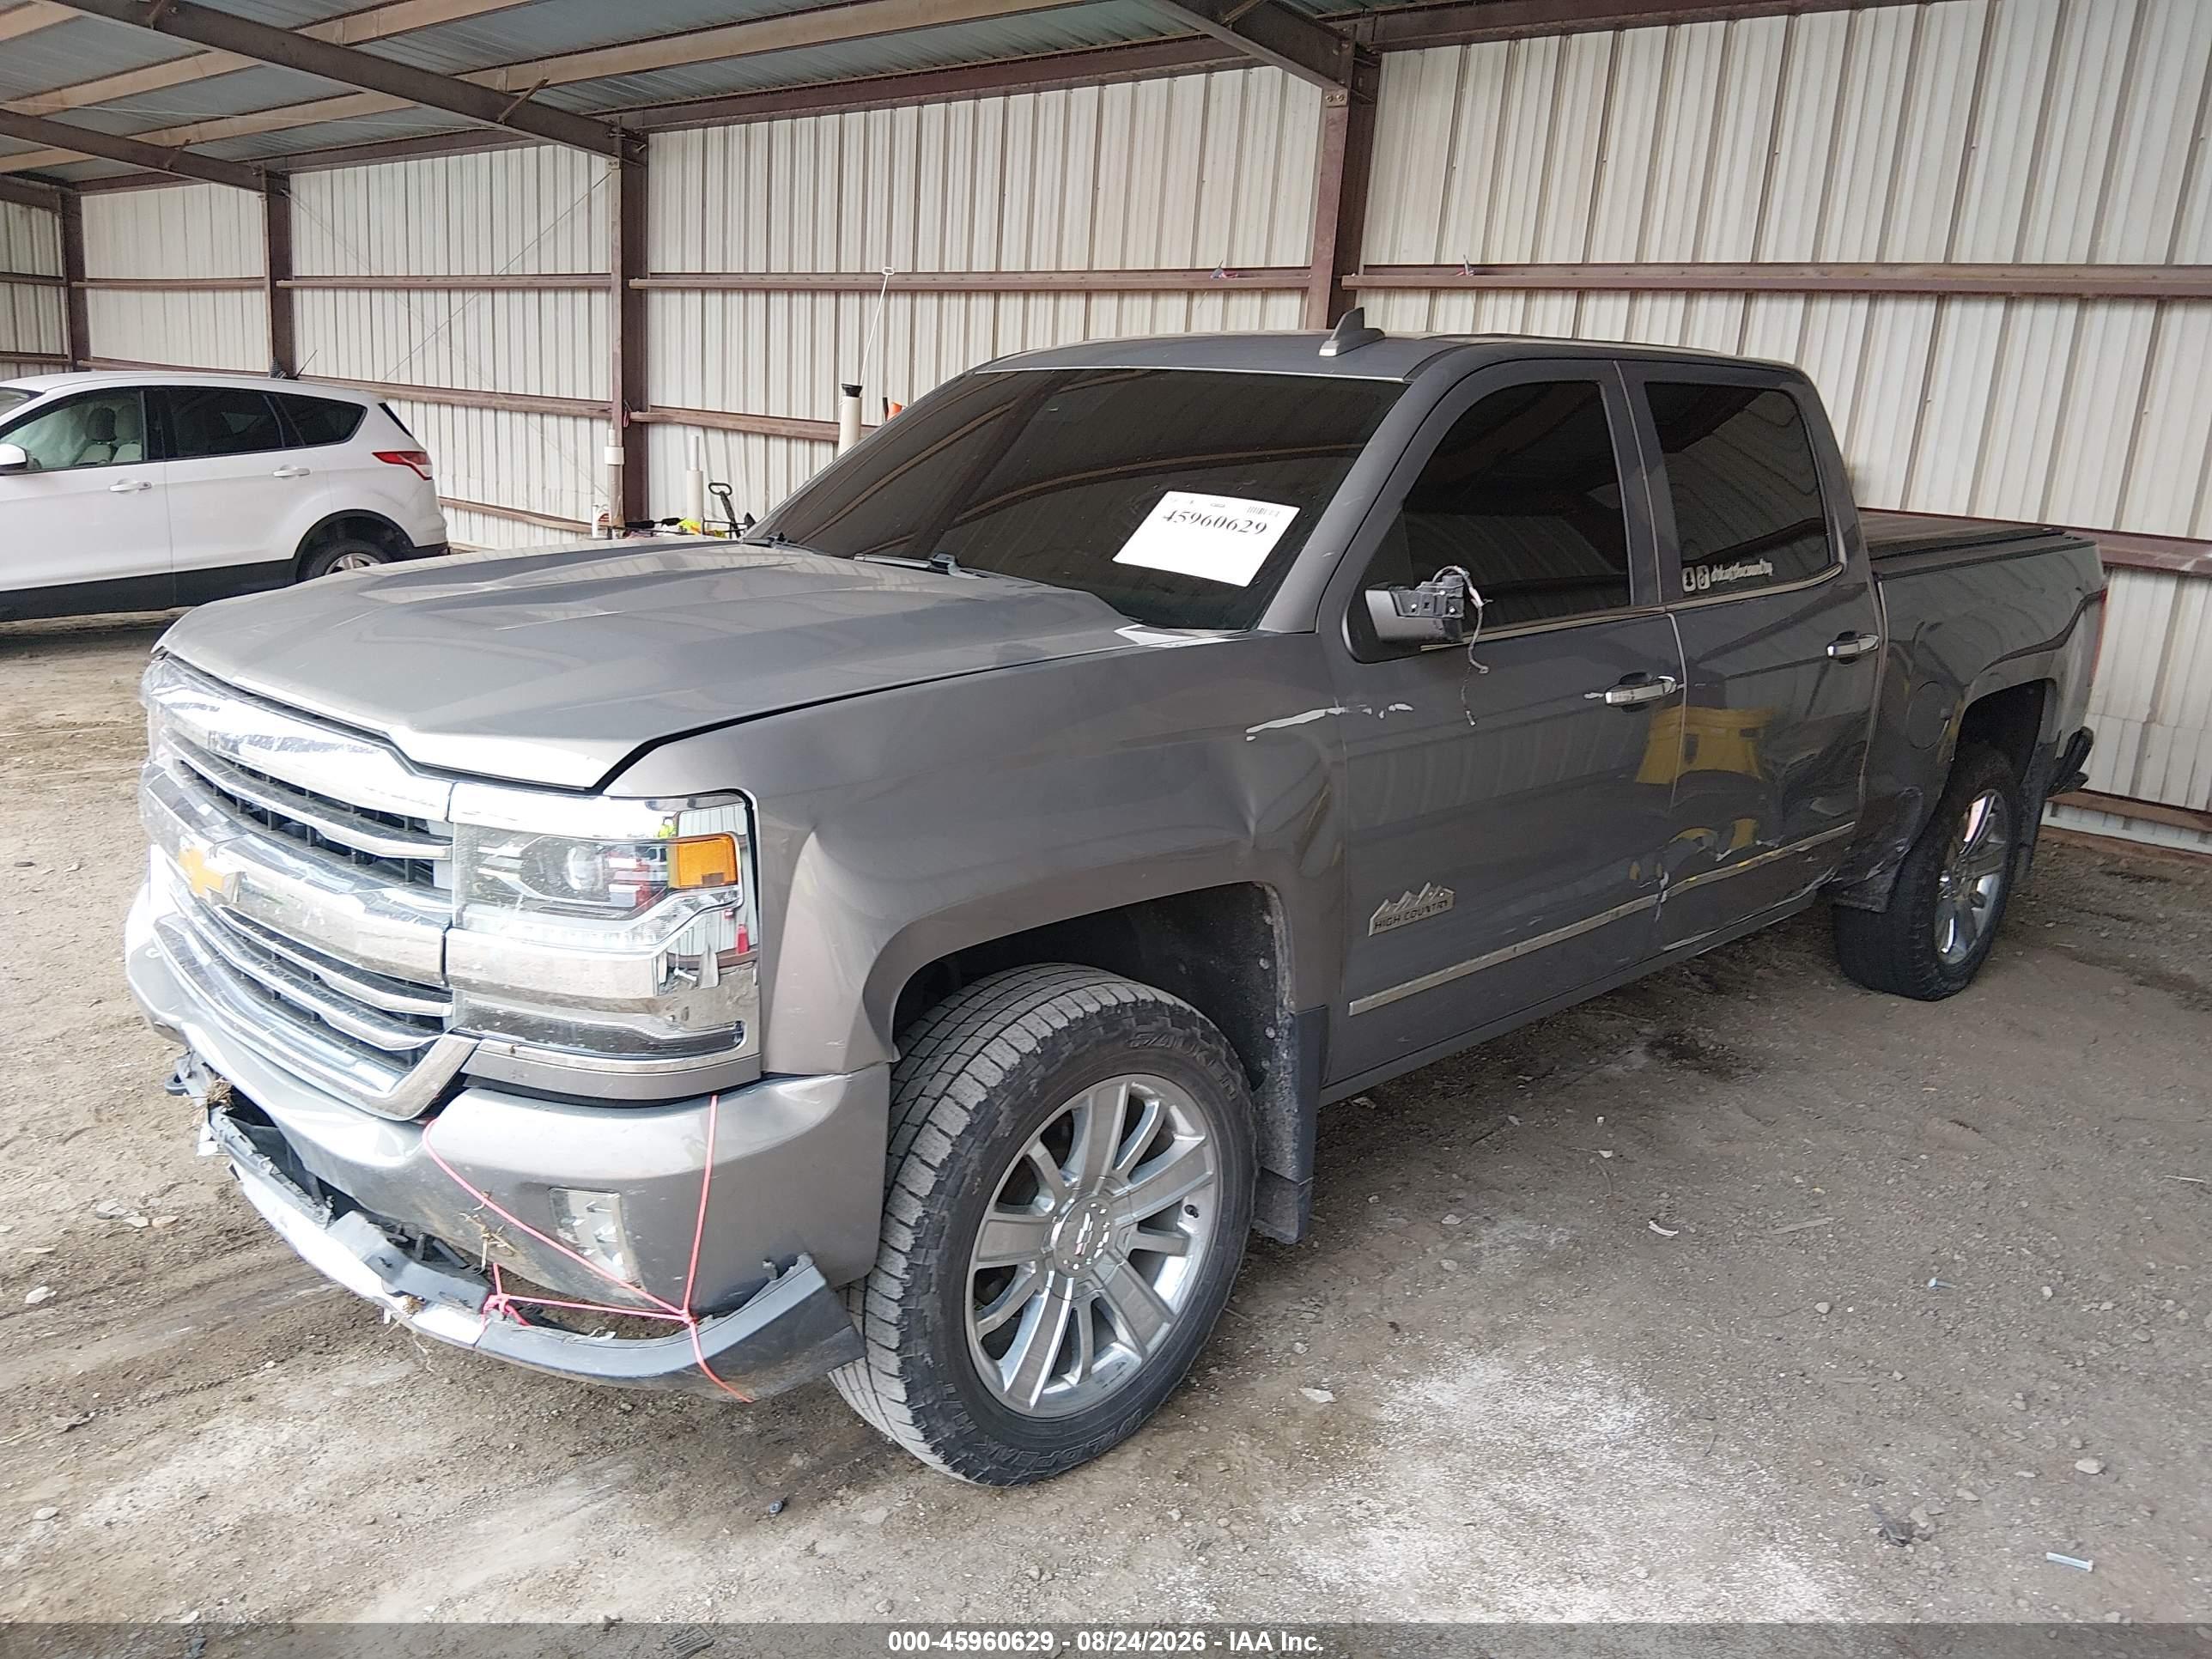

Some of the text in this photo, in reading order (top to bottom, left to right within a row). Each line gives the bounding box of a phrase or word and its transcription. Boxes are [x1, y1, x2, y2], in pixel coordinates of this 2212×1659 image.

[1163, 510, 1267, 535] 45960629
[1374, 899, 1449, 930] HIGH COUNTRY
